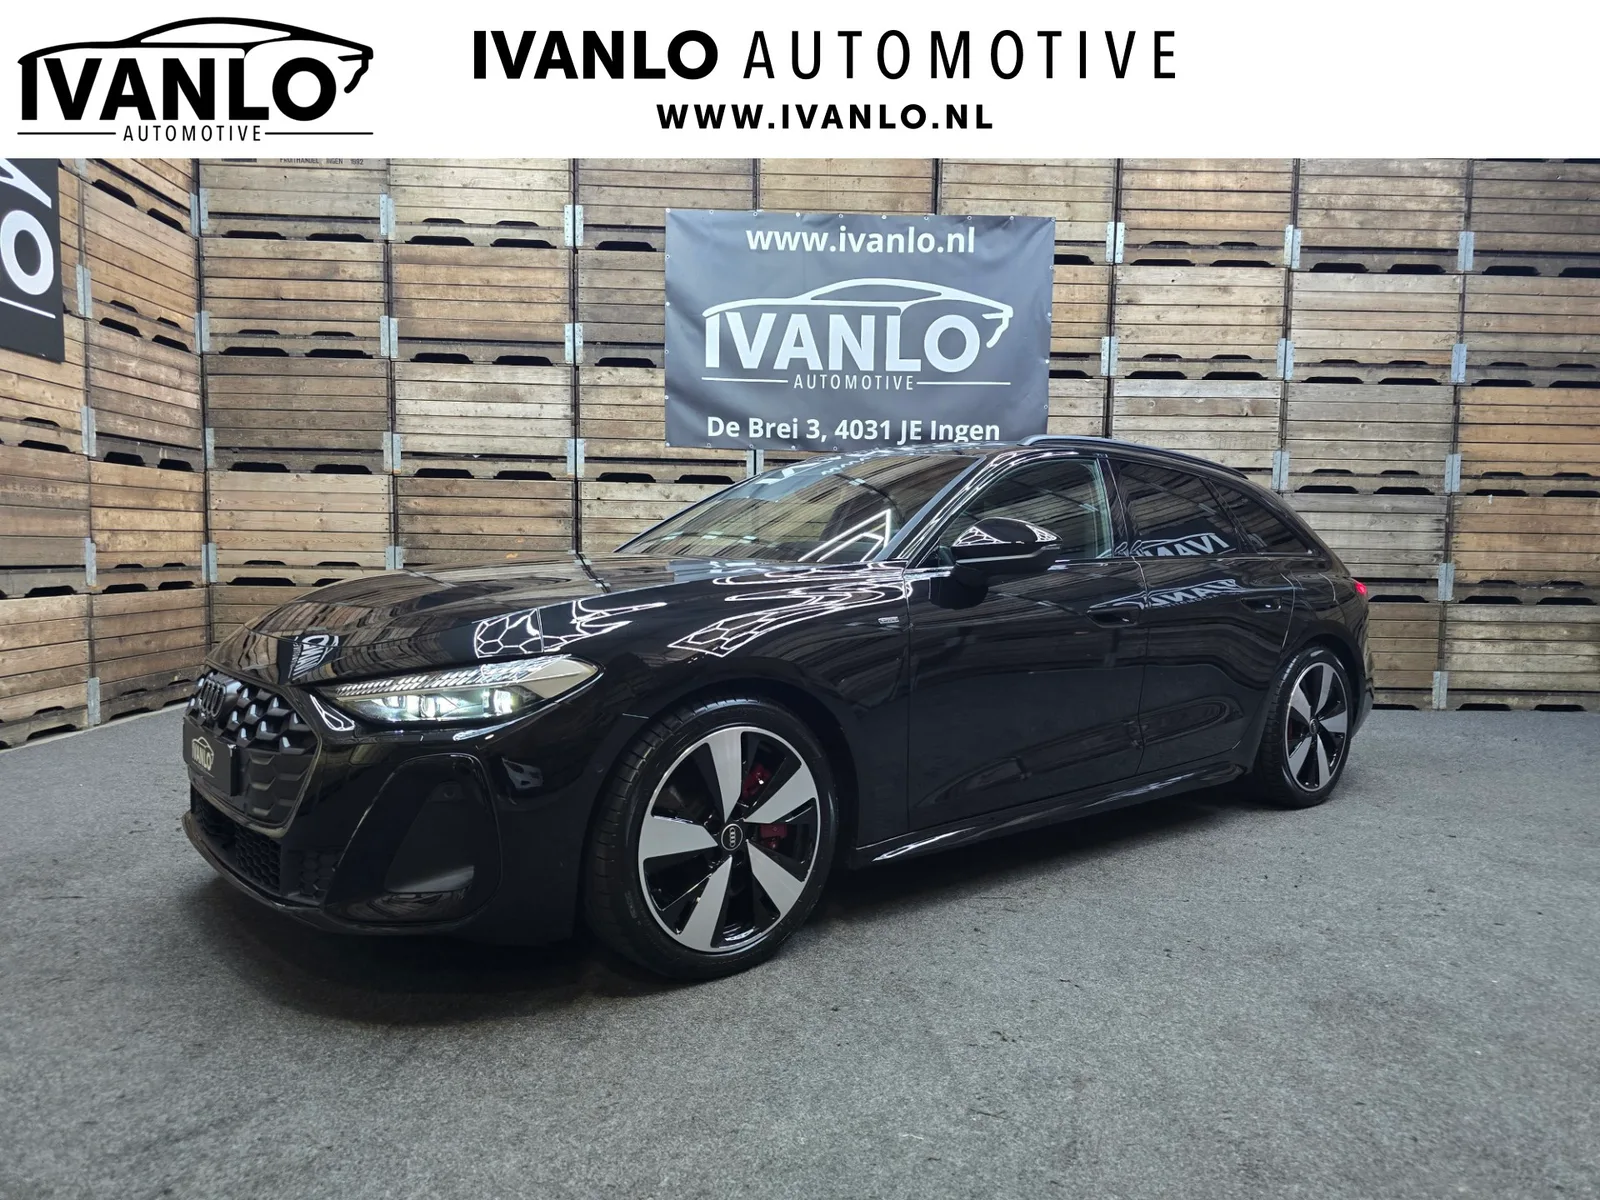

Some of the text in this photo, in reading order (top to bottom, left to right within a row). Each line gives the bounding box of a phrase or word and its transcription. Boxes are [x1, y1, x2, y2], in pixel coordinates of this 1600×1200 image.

[746, 225, 975, 254] www.ivanlo.nl
[704, 311, 981, 373] IVANLO
[793, 373, 914, 391] AUTOMOTIVE
[707, 416, 1000, 446] De Brei 3, 4031 JE Ingen
